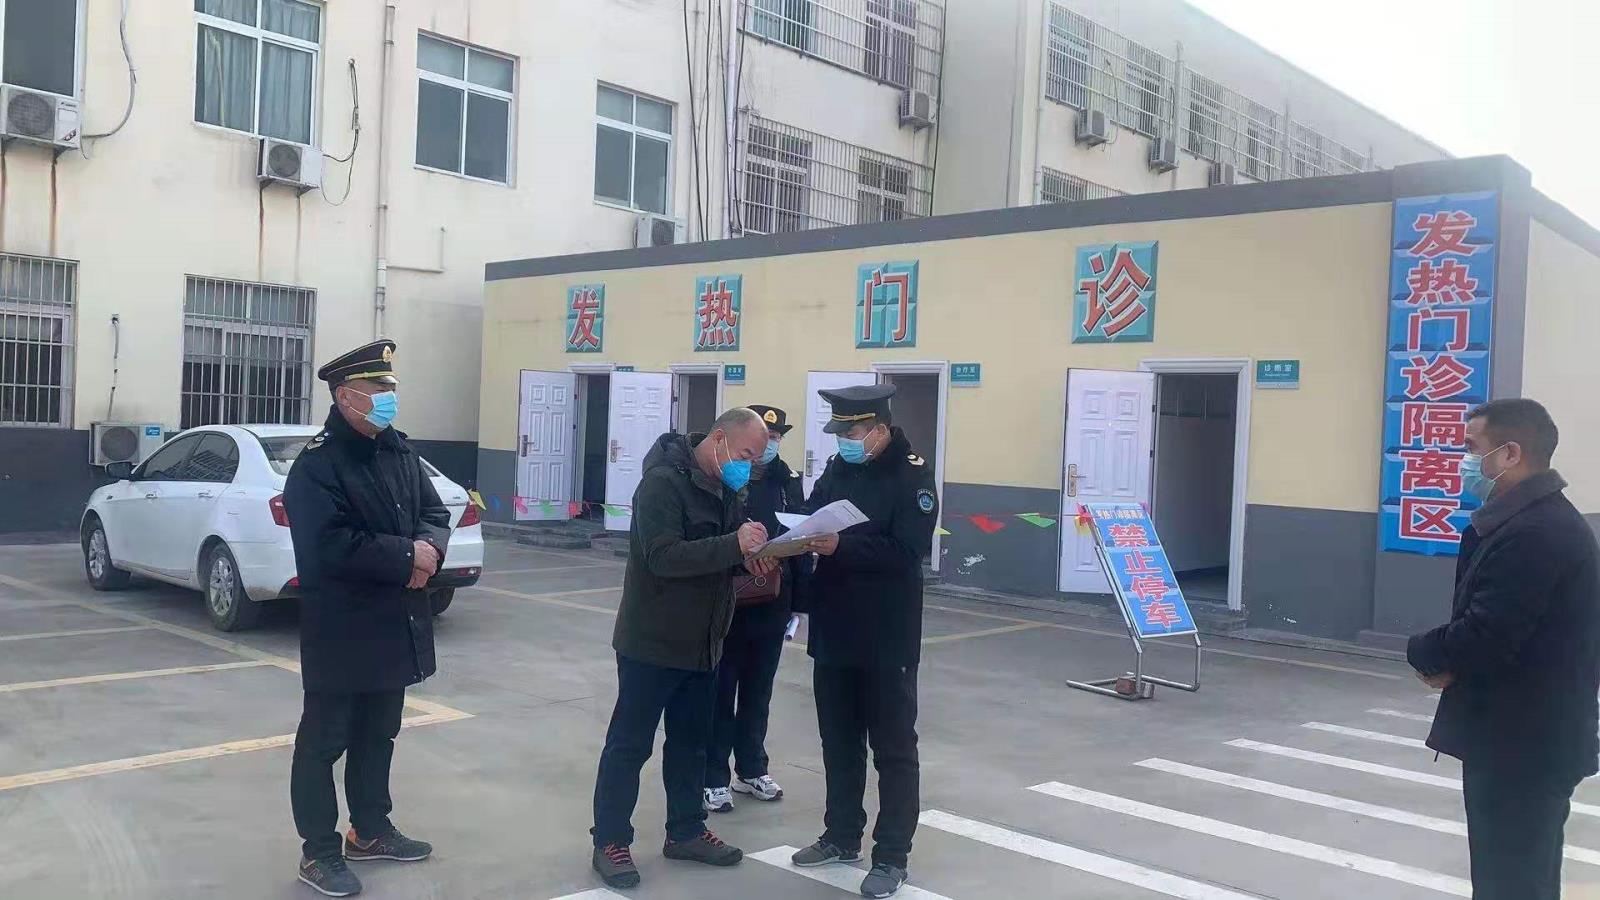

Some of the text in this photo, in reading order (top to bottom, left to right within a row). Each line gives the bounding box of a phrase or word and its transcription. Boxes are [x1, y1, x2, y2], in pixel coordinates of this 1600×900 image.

[568, 249, 1152, 348] 发热门诊
[1398, 210, 1478, 543] 发热门诊隔离区
[1109, 523, 1182, 629] 禁止停车
